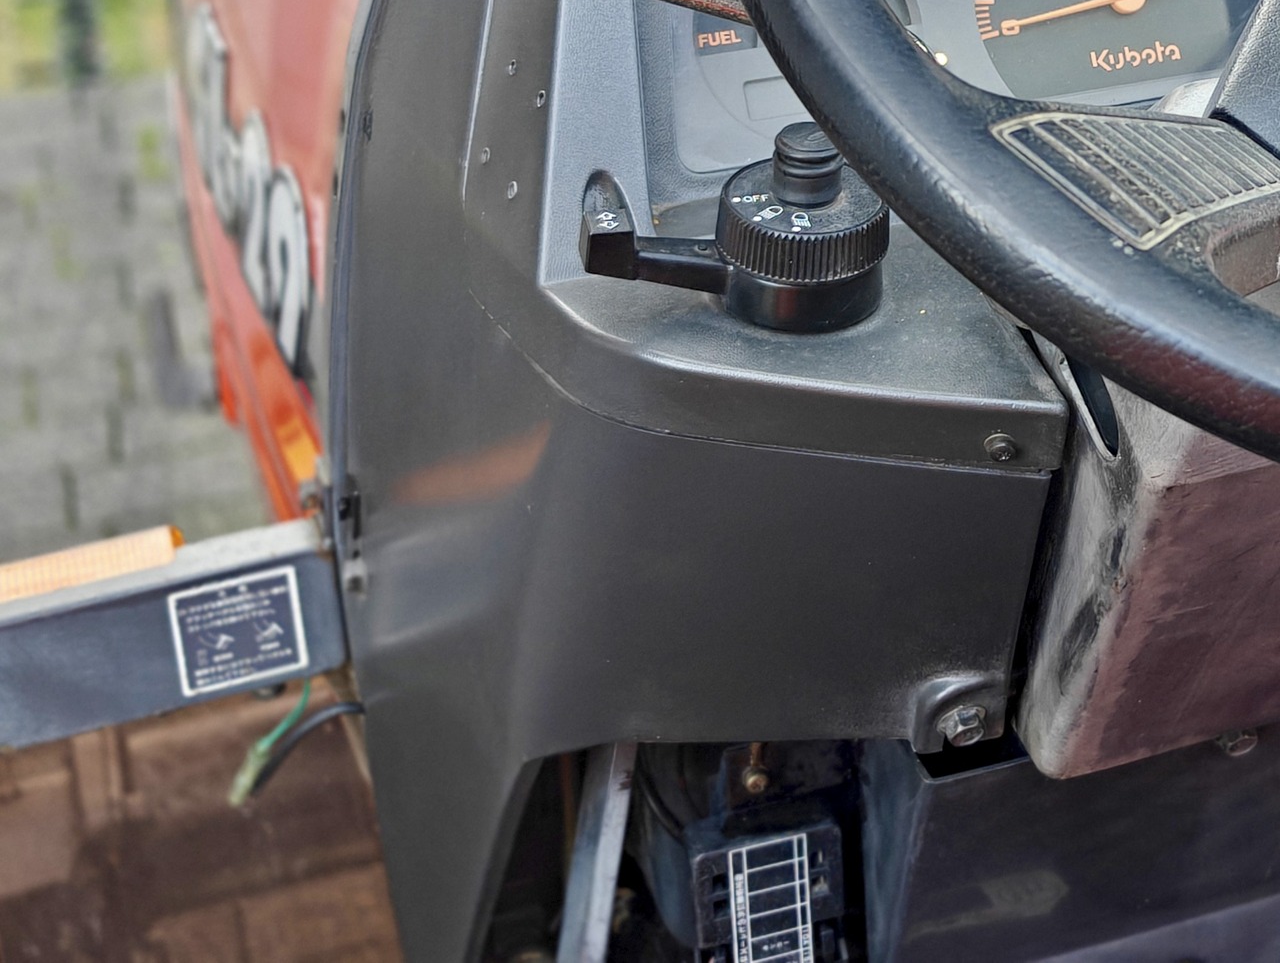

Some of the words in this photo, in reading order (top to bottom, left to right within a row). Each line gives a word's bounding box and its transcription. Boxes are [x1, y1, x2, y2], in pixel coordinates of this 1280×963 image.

[697, 29, 742, 49] FUEL
[1089, 40, 1182, 72] Kubota
[742, 193, 769, 203] OFF
